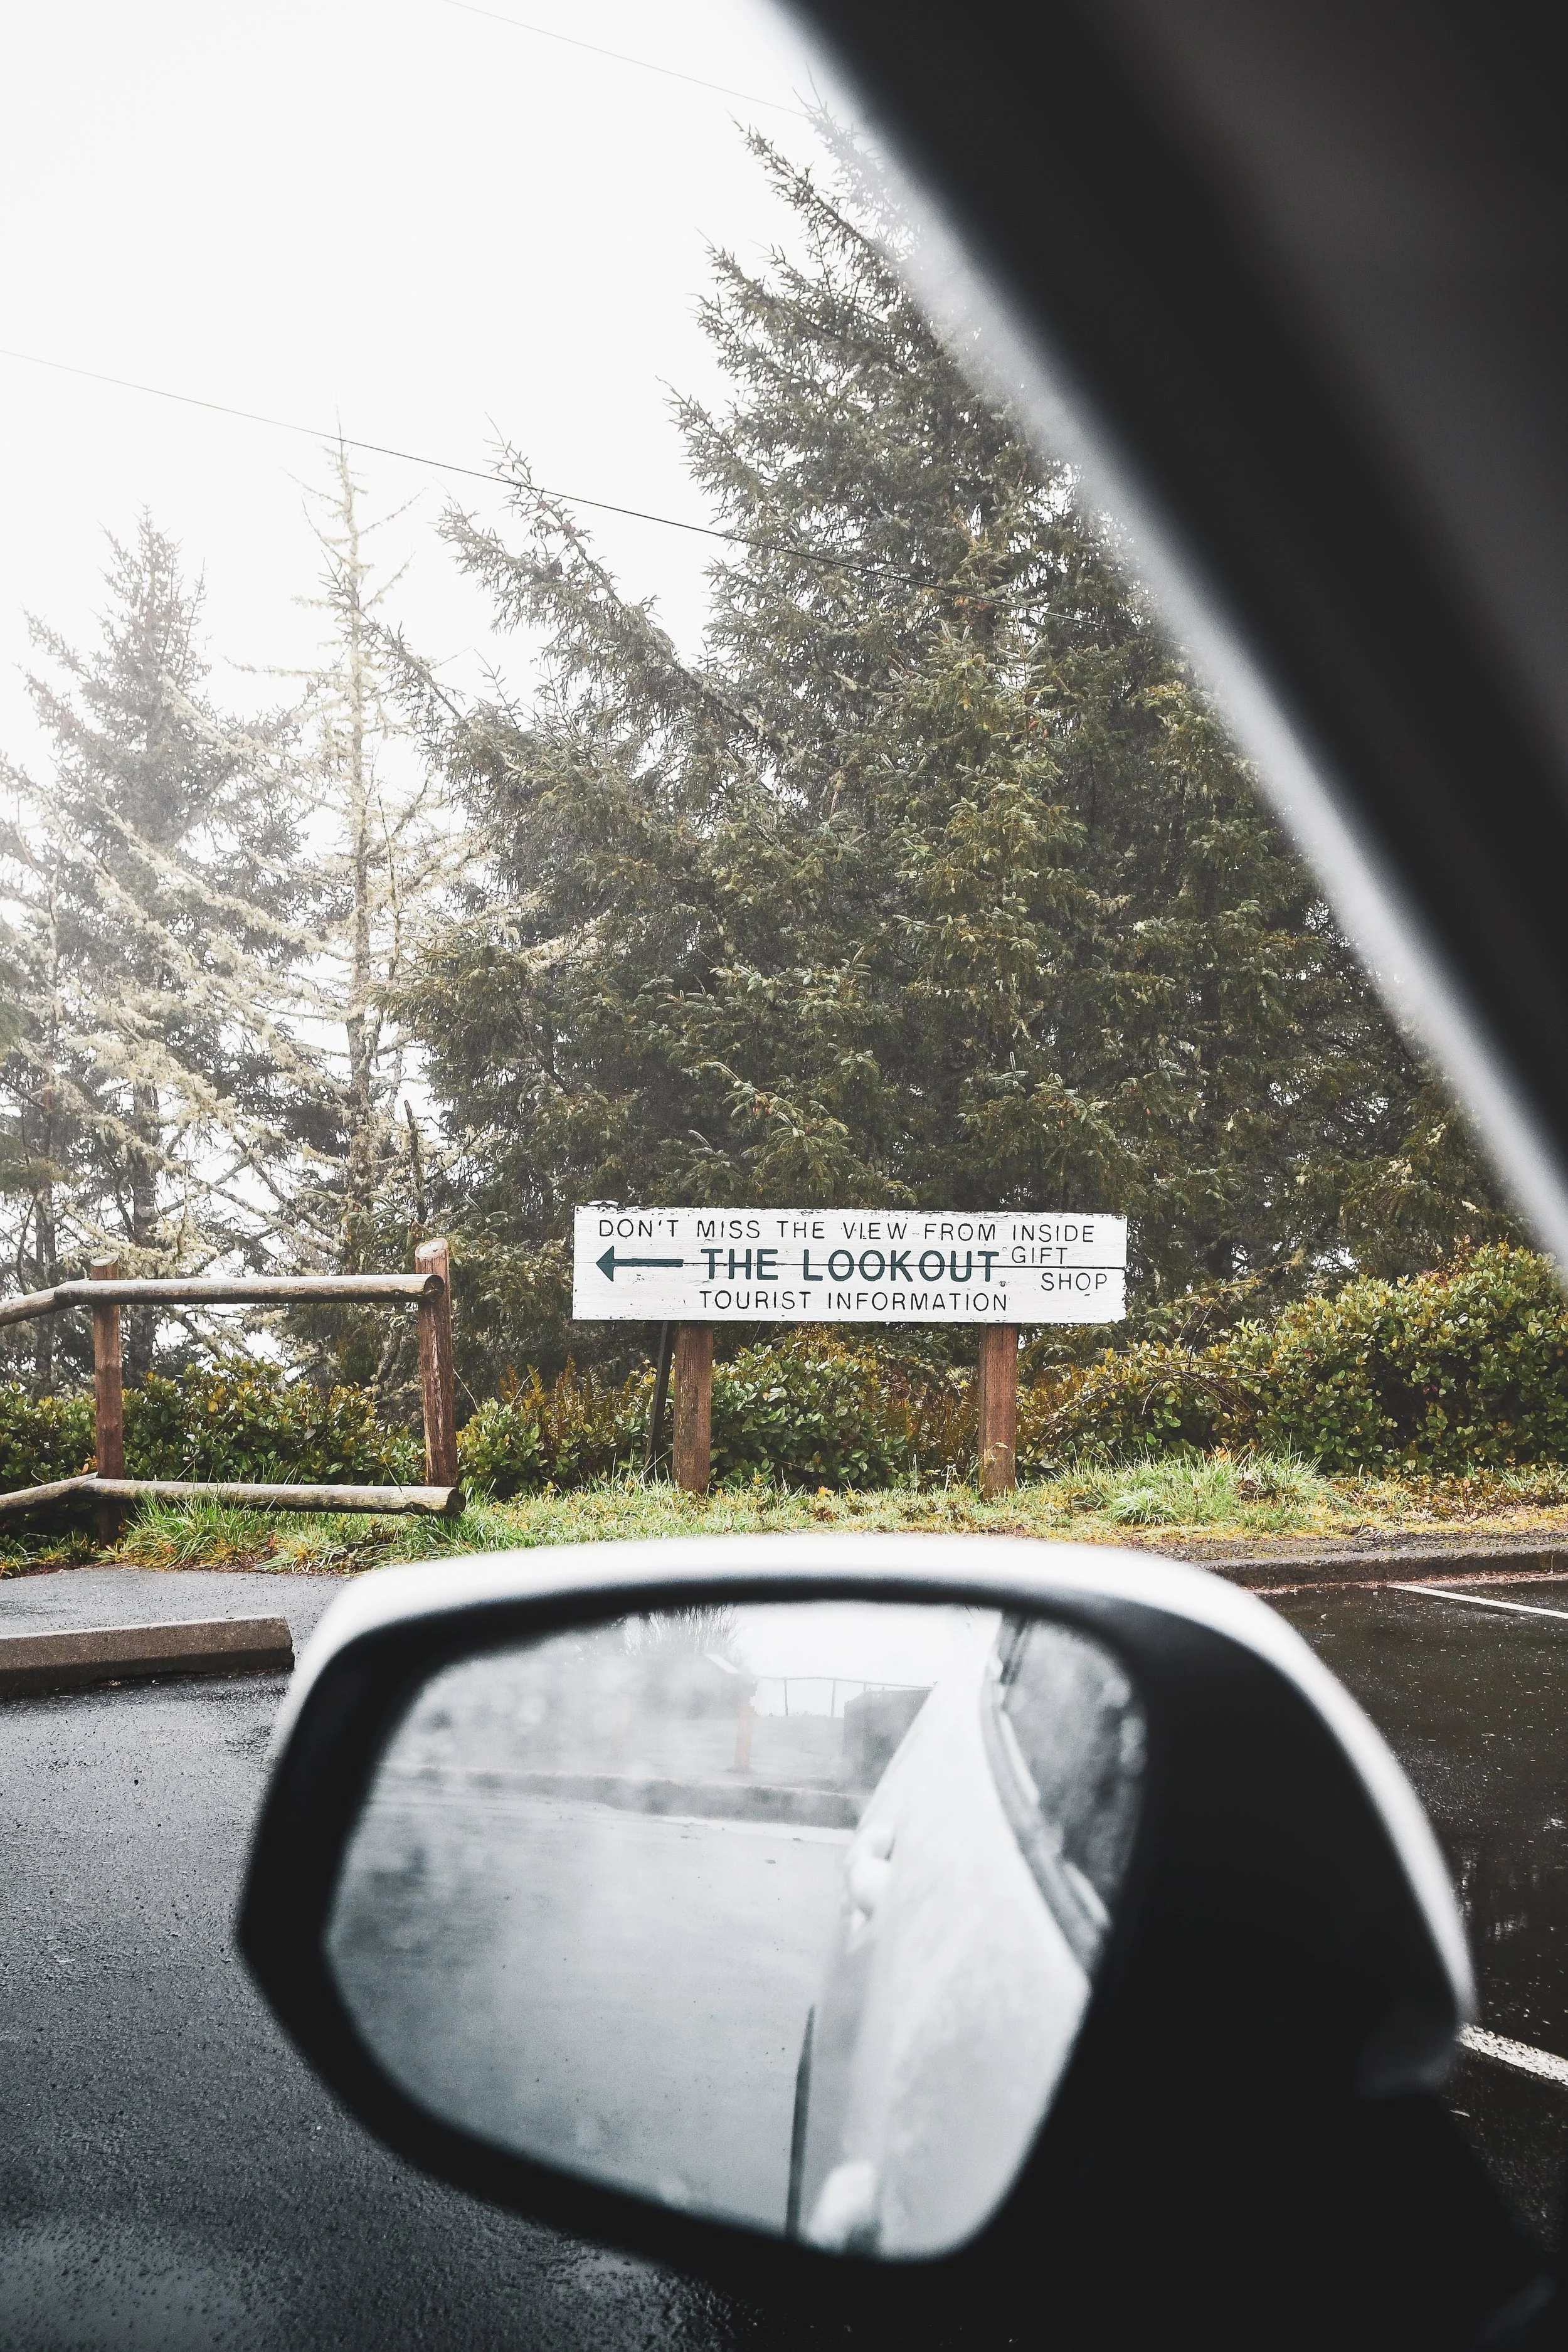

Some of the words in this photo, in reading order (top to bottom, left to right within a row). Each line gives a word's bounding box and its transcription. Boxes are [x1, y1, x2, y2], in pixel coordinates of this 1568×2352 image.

[599, 1219, 679, 1237] DON'T
[697, 1219, 760, 1239] MISS
[776, 1221, 825, 1239] THE
[843, 1222, 907, 1240] VIEW
[924, 1223, 995, 1241] FROM
[1013, 1224, 1094, 1242] INSIDE
[701, 1248, 778, 1280] THE
[803, 1249, 999, 1282] LOOKOUT
[1012, 1246, 1067, 1264] GIFT
[1041, 1272, 1108, 1291] SHOP
[699, 1290, 811, 1310] TOURIST
[828, 1291, 1007, 1311] INFORMATION
